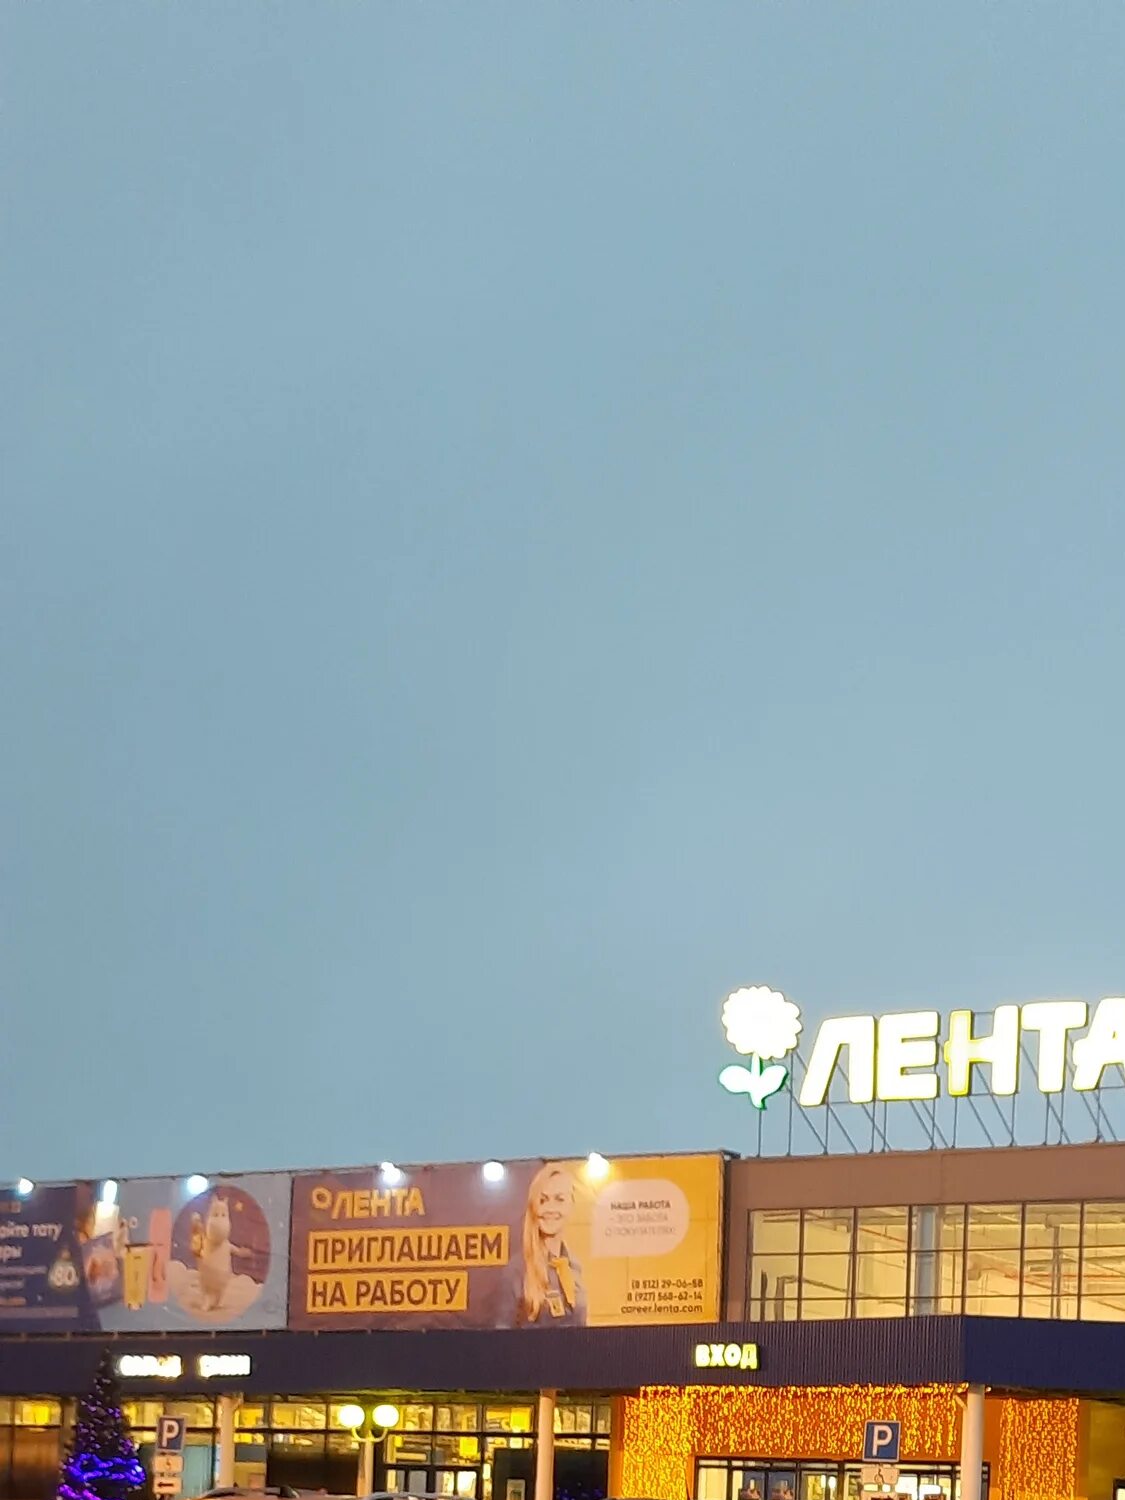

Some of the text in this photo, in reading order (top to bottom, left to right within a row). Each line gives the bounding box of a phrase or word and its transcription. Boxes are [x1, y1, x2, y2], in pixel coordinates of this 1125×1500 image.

[331, 1186, 426, 1219] ЛЕНТА
[312, 1232, 503, 1263] ПРИГЛАШАЕМ
[311, 1278, 461, 1307] НА РАБОТУ
[620, 1303, 703, 1314] career.lenta.com
[695, 1343, 758, 1369] ВХОД
[161, 1420, 180, 1447] P
[872, 1425, 892, 1456] P
